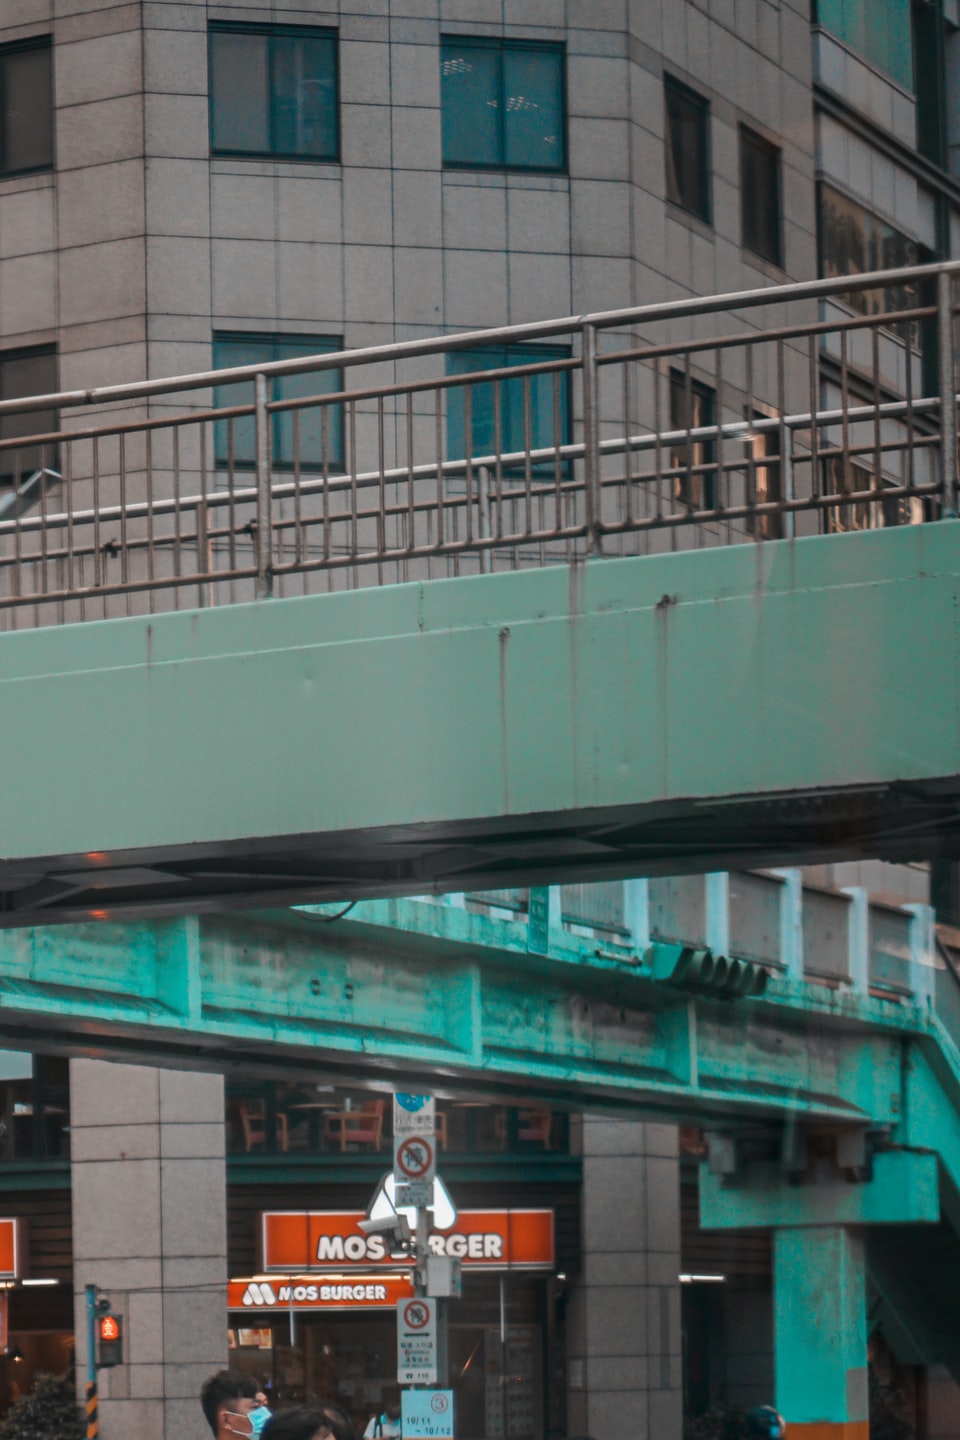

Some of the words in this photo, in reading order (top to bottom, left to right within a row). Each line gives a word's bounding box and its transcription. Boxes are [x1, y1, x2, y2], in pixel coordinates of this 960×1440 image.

[317, 1235, 386, 1261] MOS
[390, 1233, 503, 1260] RGER
[278, 1286, 318, 1301] MOS
[320, 1285, 386, 1300] BURGER
[406, 1416, 431, 1425] 10/11
[425, 1426, 451, 1435] 10/12
